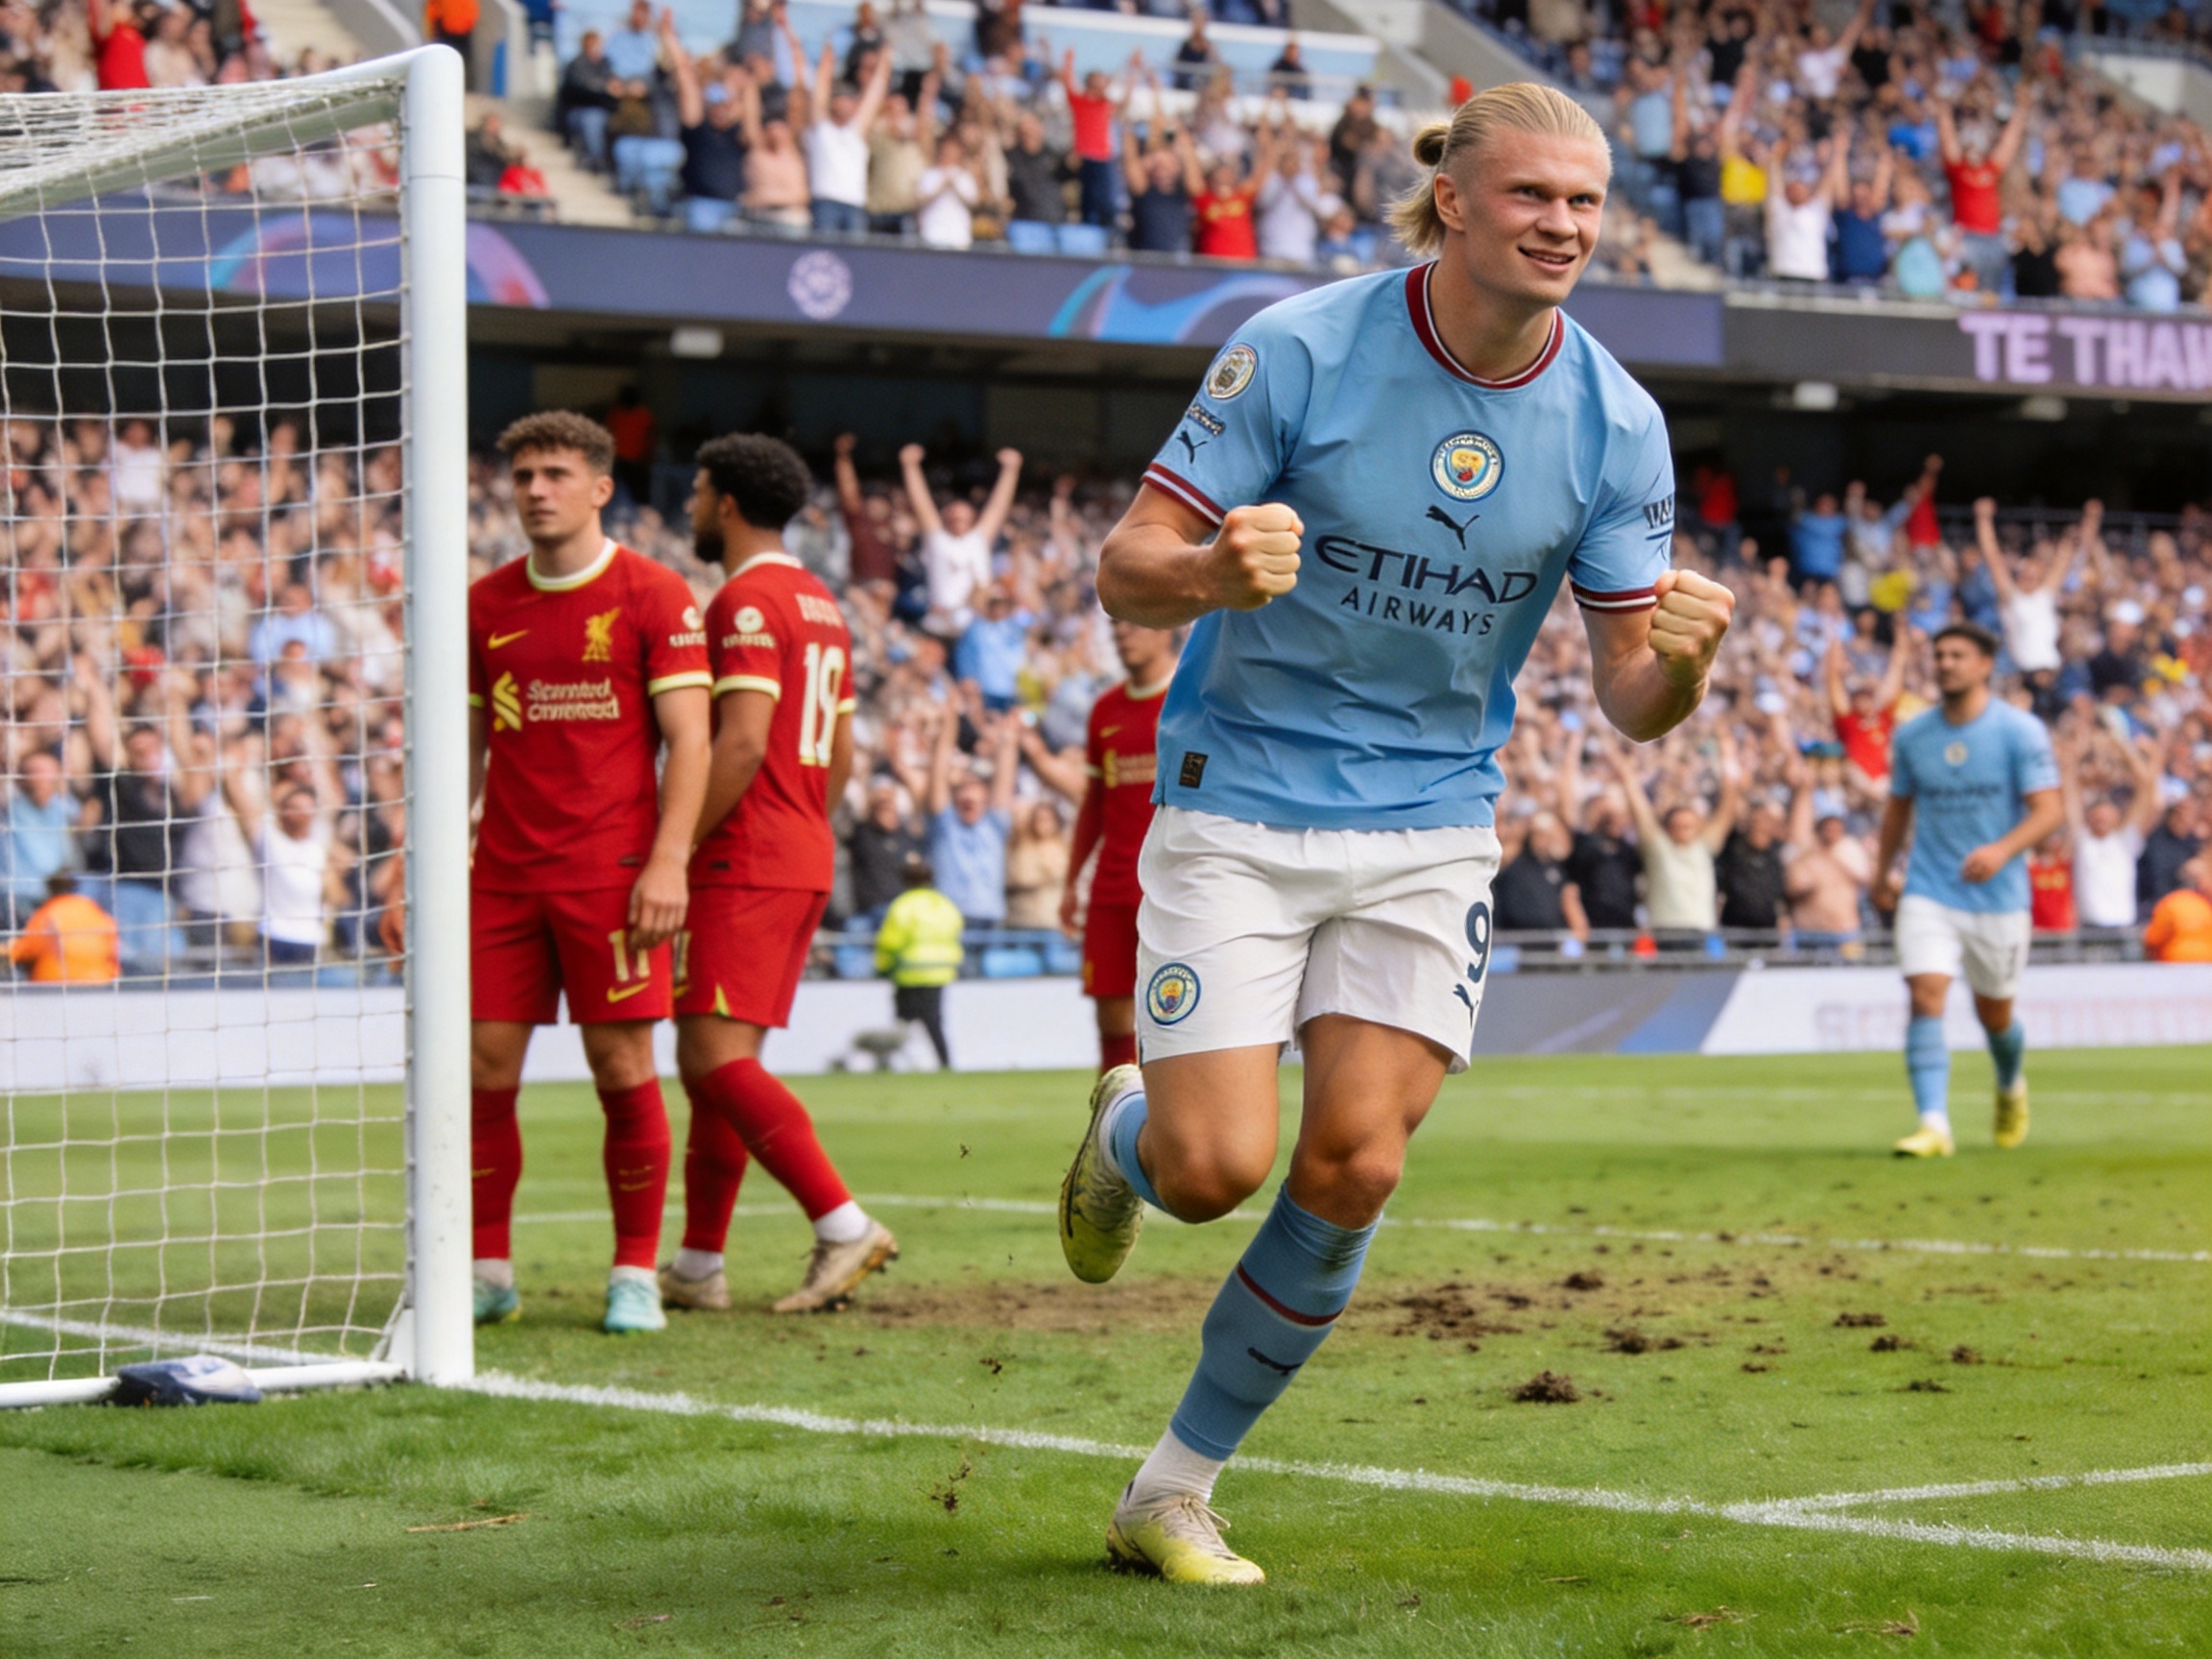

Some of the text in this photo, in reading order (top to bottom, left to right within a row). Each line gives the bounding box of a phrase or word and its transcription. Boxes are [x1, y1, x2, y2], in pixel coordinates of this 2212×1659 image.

[1958, 312, 2053, 383] TE
[1314, 534, 1538, 605] ETIHAD
[1339, 586, 1495, 637] AIRWAYS
[799, 641, 846, 768] 19
[1465, 901, 1491, 984] 9
